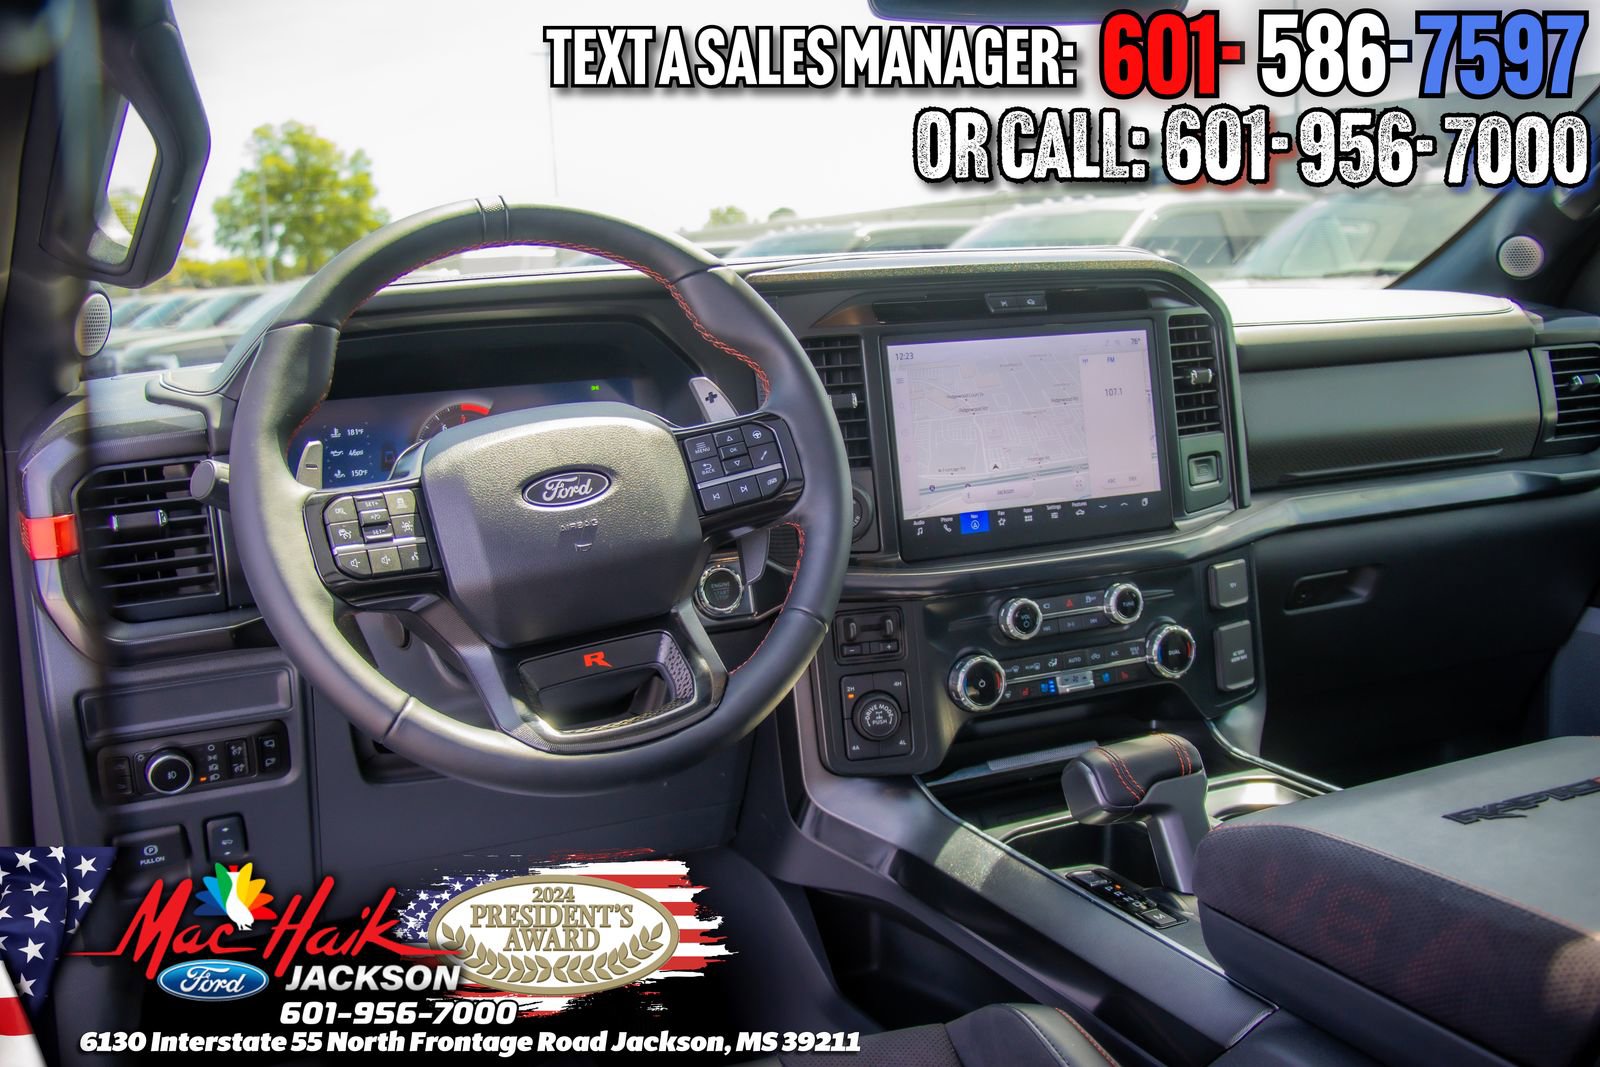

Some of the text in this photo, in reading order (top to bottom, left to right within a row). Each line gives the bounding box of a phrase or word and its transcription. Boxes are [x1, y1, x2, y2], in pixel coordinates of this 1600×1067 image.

[895, 352, 914, 360] 12:23
[1104, 388, 1123, 397] 107.1
[542, 475, 593, 502] Ford
[583, 651, 612, 668] R
[865, 703, 894, 721] DRIVE MODE
